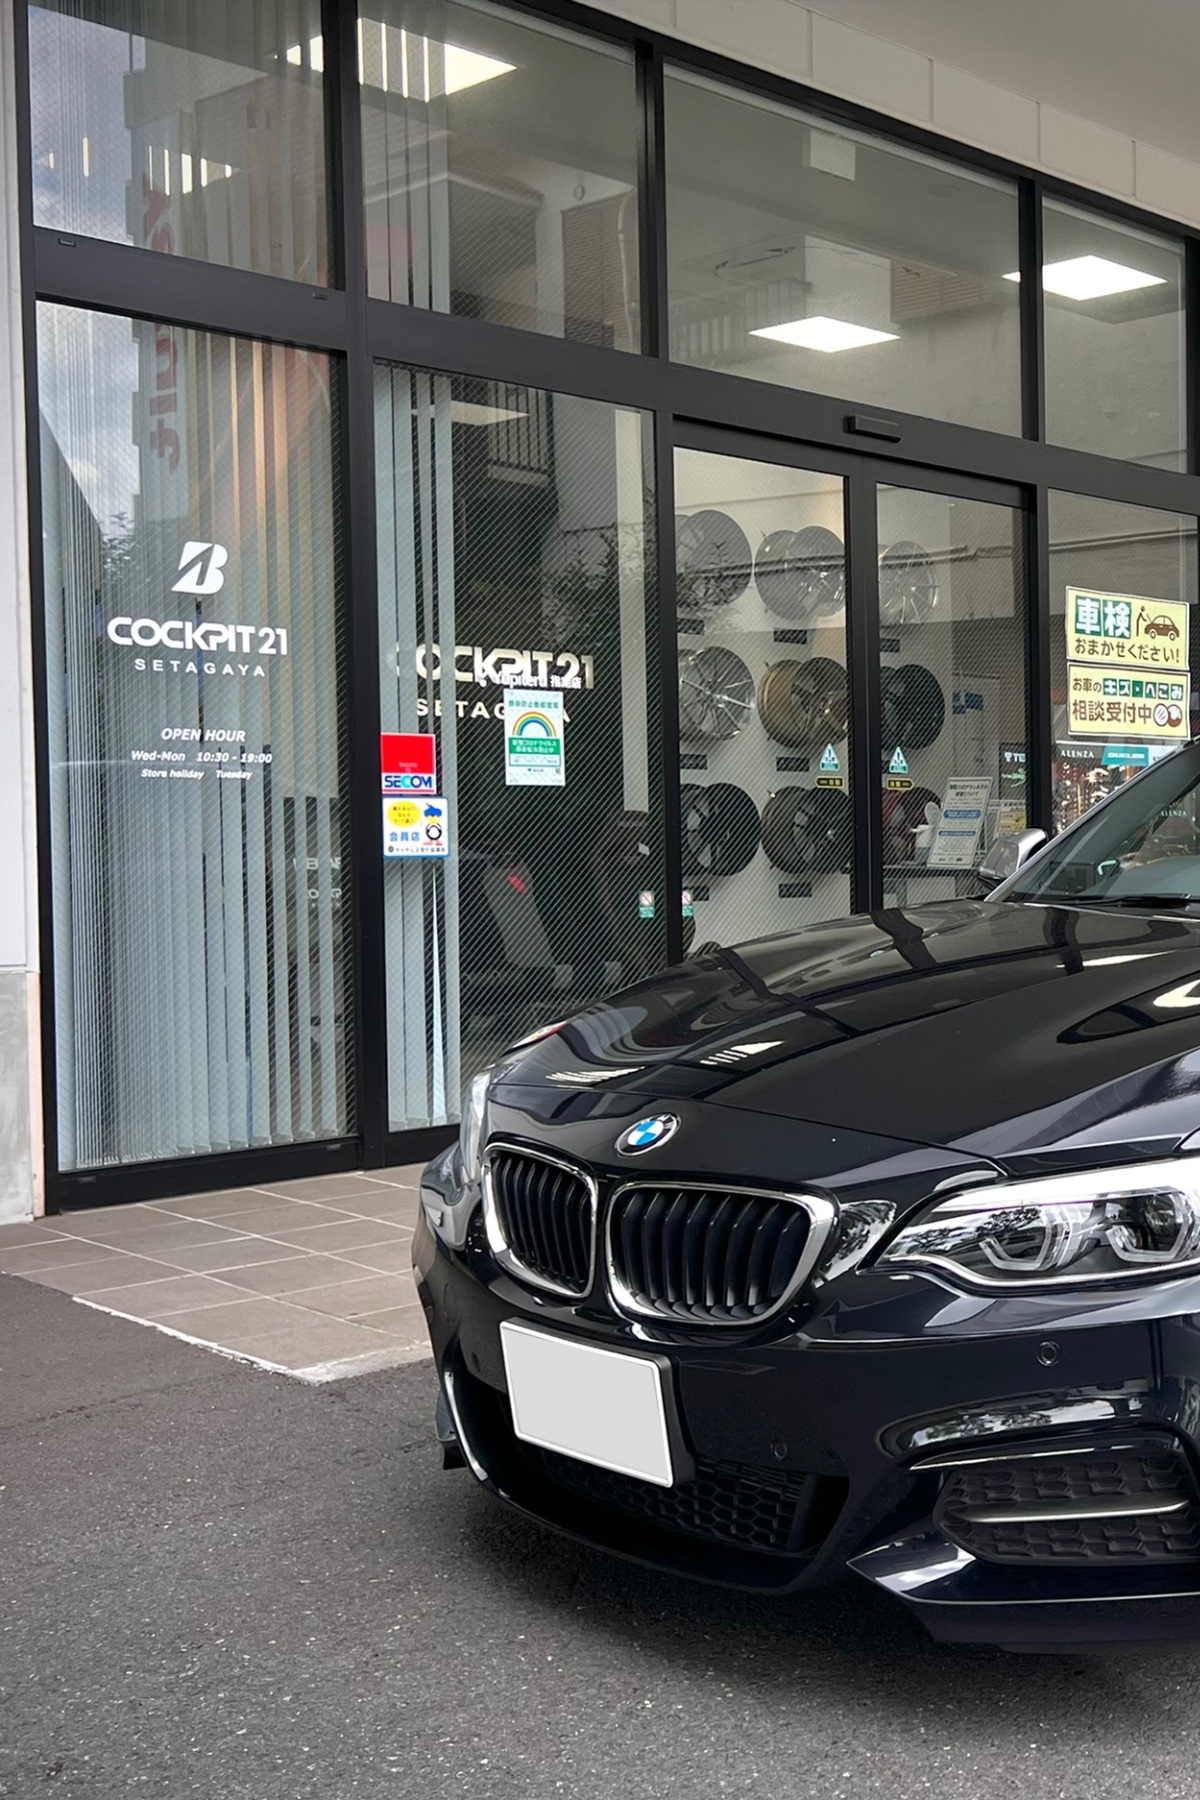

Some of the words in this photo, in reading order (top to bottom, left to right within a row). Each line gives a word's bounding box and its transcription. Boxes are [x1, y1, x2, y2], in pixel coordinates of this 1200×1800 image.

[1075, 598, 1130, 638] 車検
[134, 657, 266, 678] SETAGAYA
[1072, 701, 1152, 724] 相談受付中
[161, 728, 201, 742] OPEN
[204, 729, 246, 743] HOUR
[131, 750, 186, 762] Wed-Mon
[196, 752, 230, 763] 10:30
[240, 752, 273, 764] 19:00
[1060, 749, 1095, 759] ALENZA
[141, 768, 168, 778] Store
[169, 768, 205, 780] holiday
[216, 769, 253, 780] Tuesday
[384, 774, 433, 789] SECOM
[389, 831, 420, 842] 会員店
